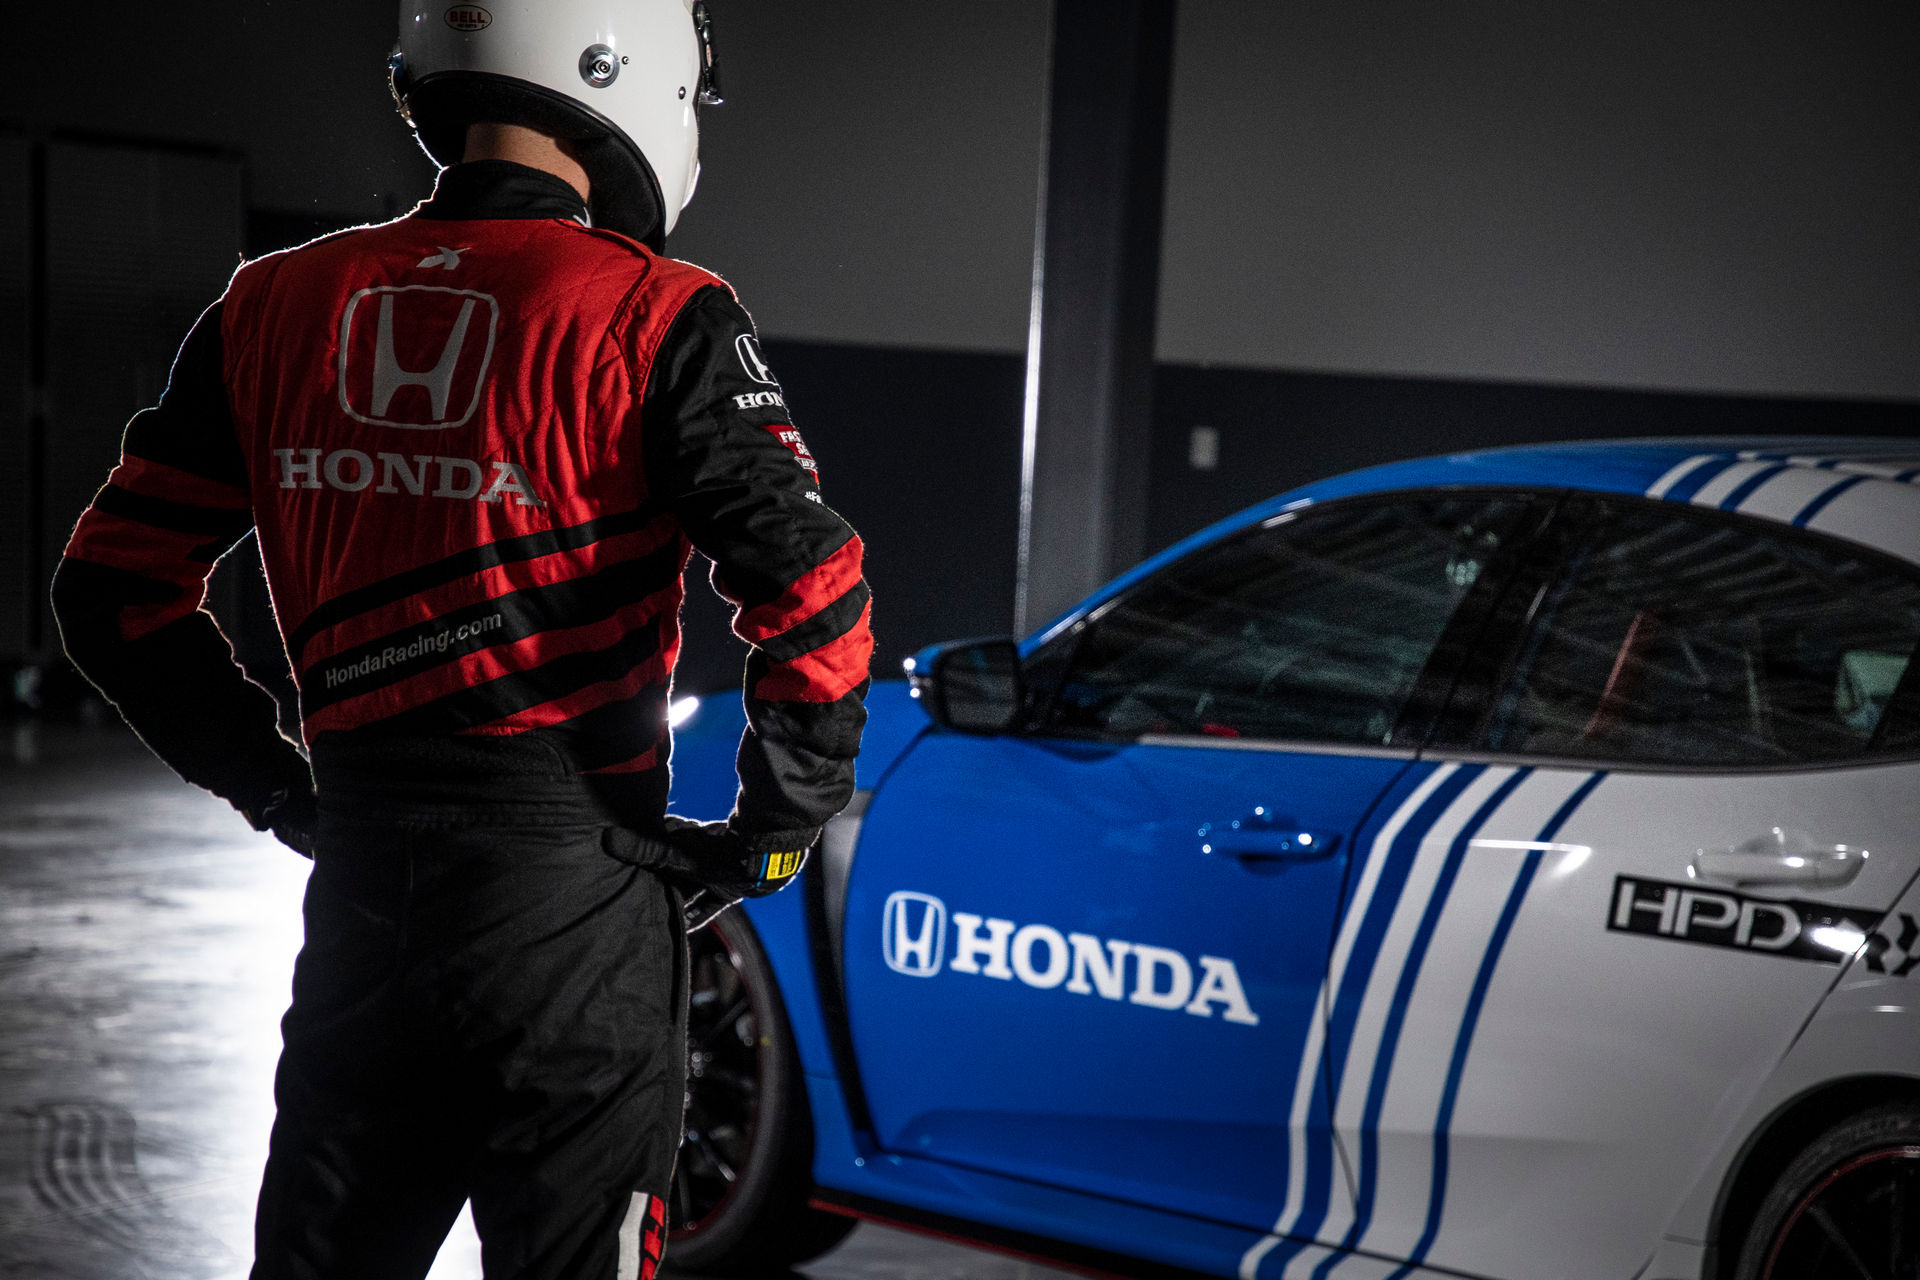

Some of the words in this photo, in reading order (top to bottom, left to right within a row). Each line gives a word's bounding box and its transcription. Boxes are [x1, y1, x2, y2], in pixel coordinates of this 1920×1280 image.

[450, 11, 485, 24] BELL
[273, 447, 548, 508] HONDA
[325, 613, 501, 688] HondaRacing.com
[1614, 880, 1802, 950] HPD
[949, 911, 1260, 1027] HONDA
